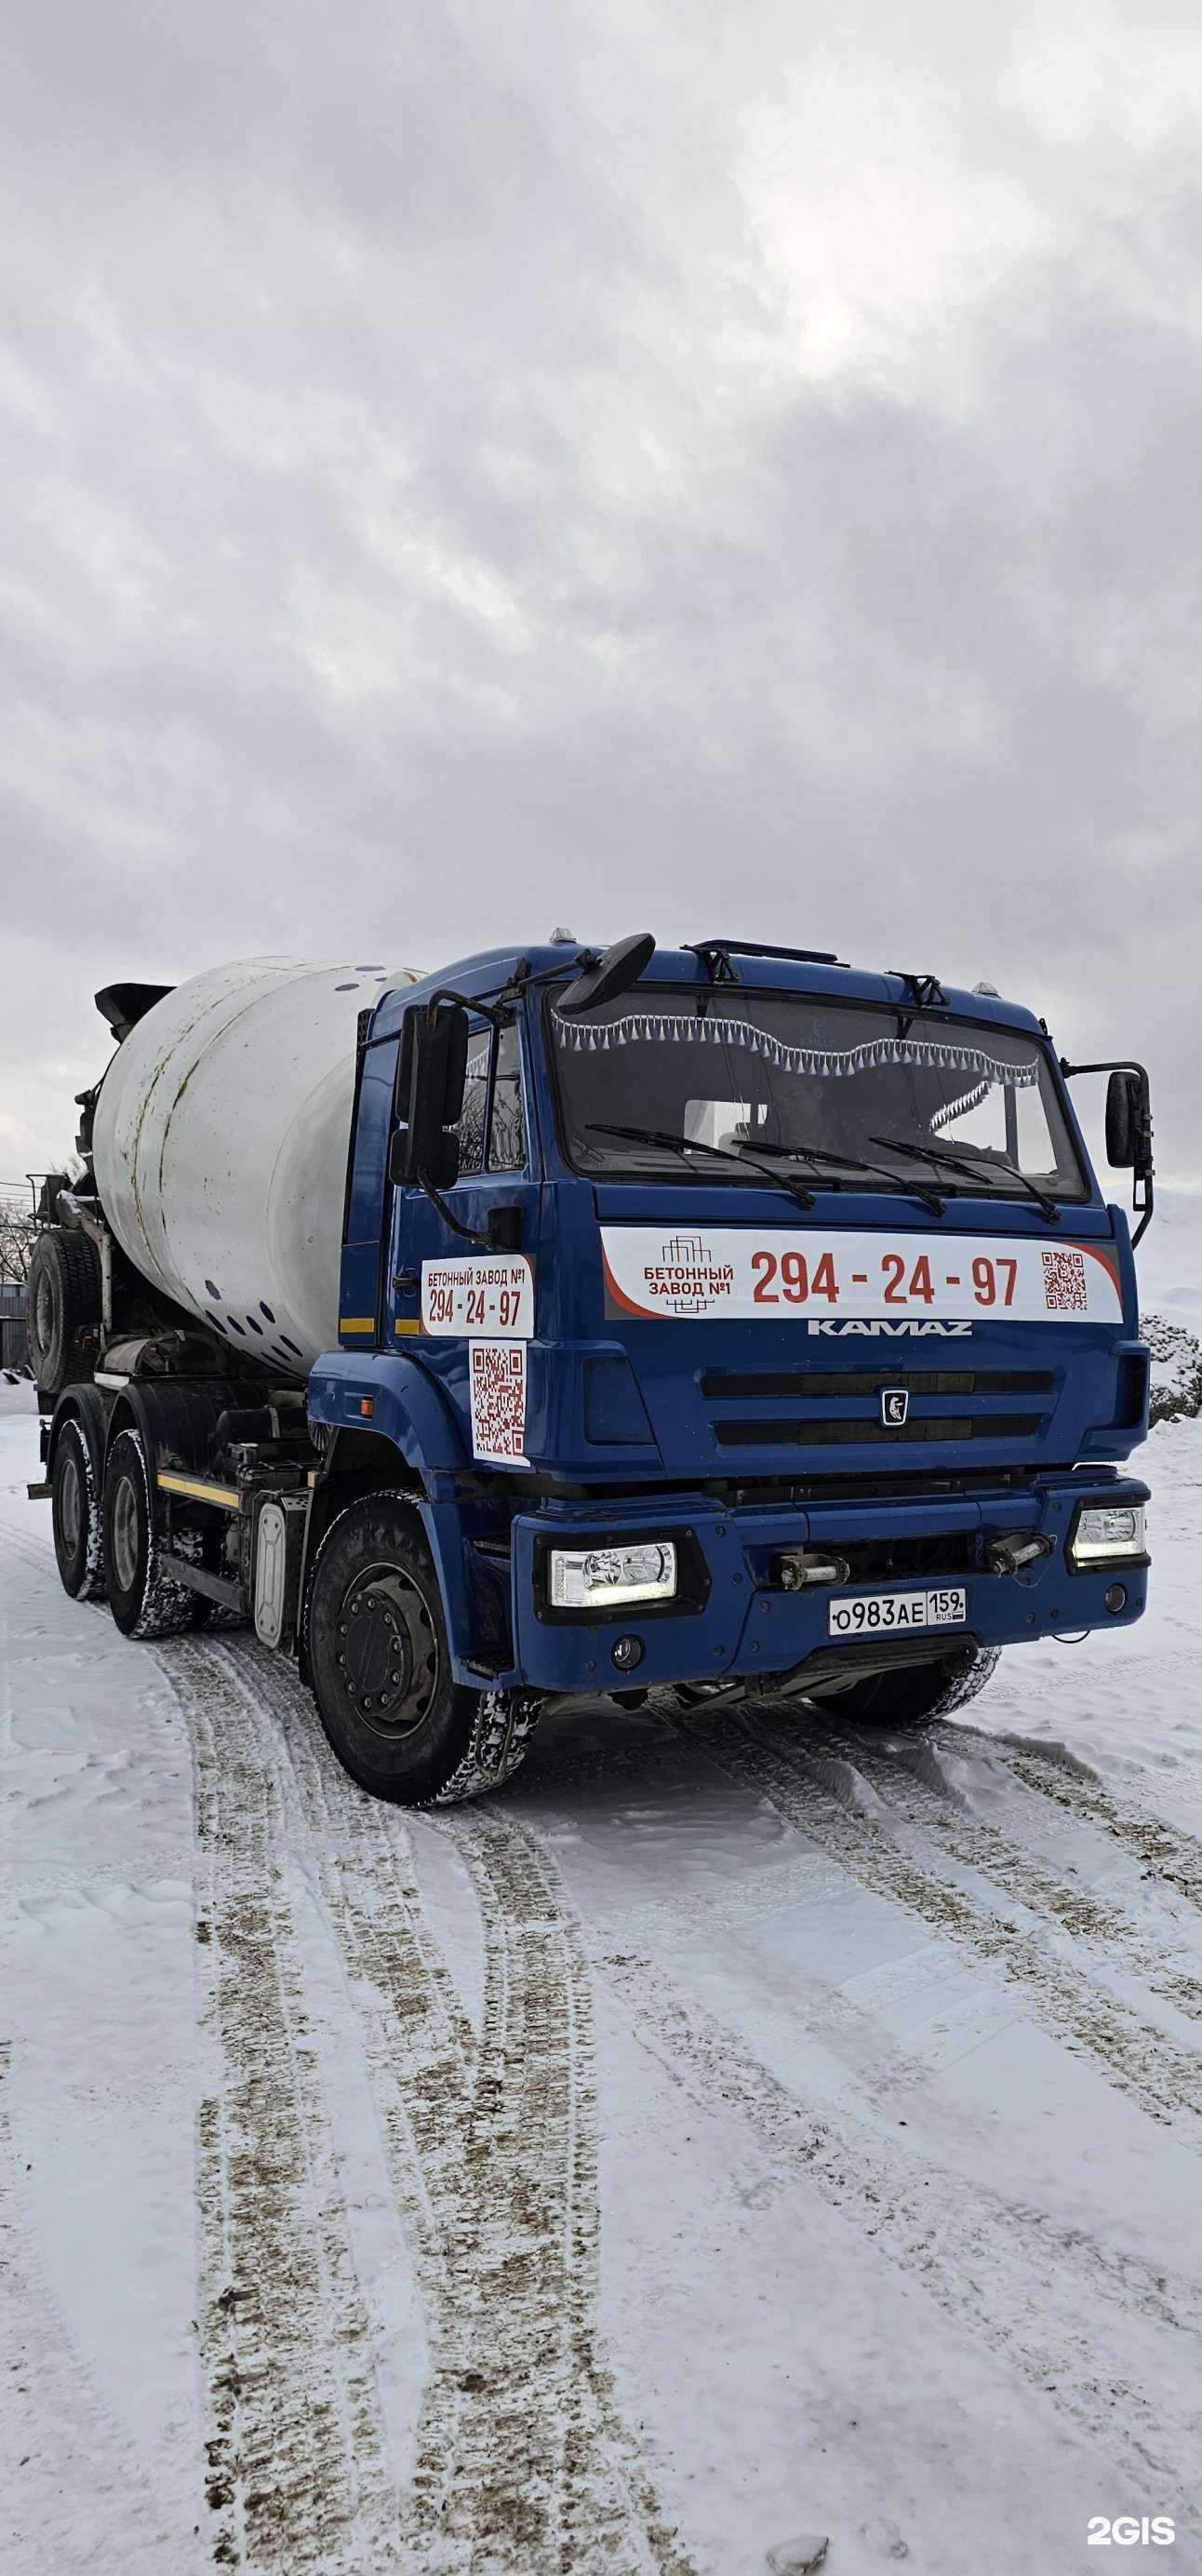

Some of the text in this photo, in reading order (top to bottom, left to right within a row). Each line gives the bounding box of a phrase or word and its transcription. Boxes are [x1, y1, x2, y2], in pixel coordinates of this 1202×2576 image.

[428, 1267, 474, 1287] БЕТОННЫЙ
[475, 1269, 508, 1287] ЗАВОД
[644, 1265, 734, 1280] БЕТОННЫЙ
[648, 1282, 704, 1296] ЗАВОД
[808, 1320, 973, 1335] KAMAZ
[928, 1591, 960, 1613] 159
[936, 1612, 952, 1621] RUS
